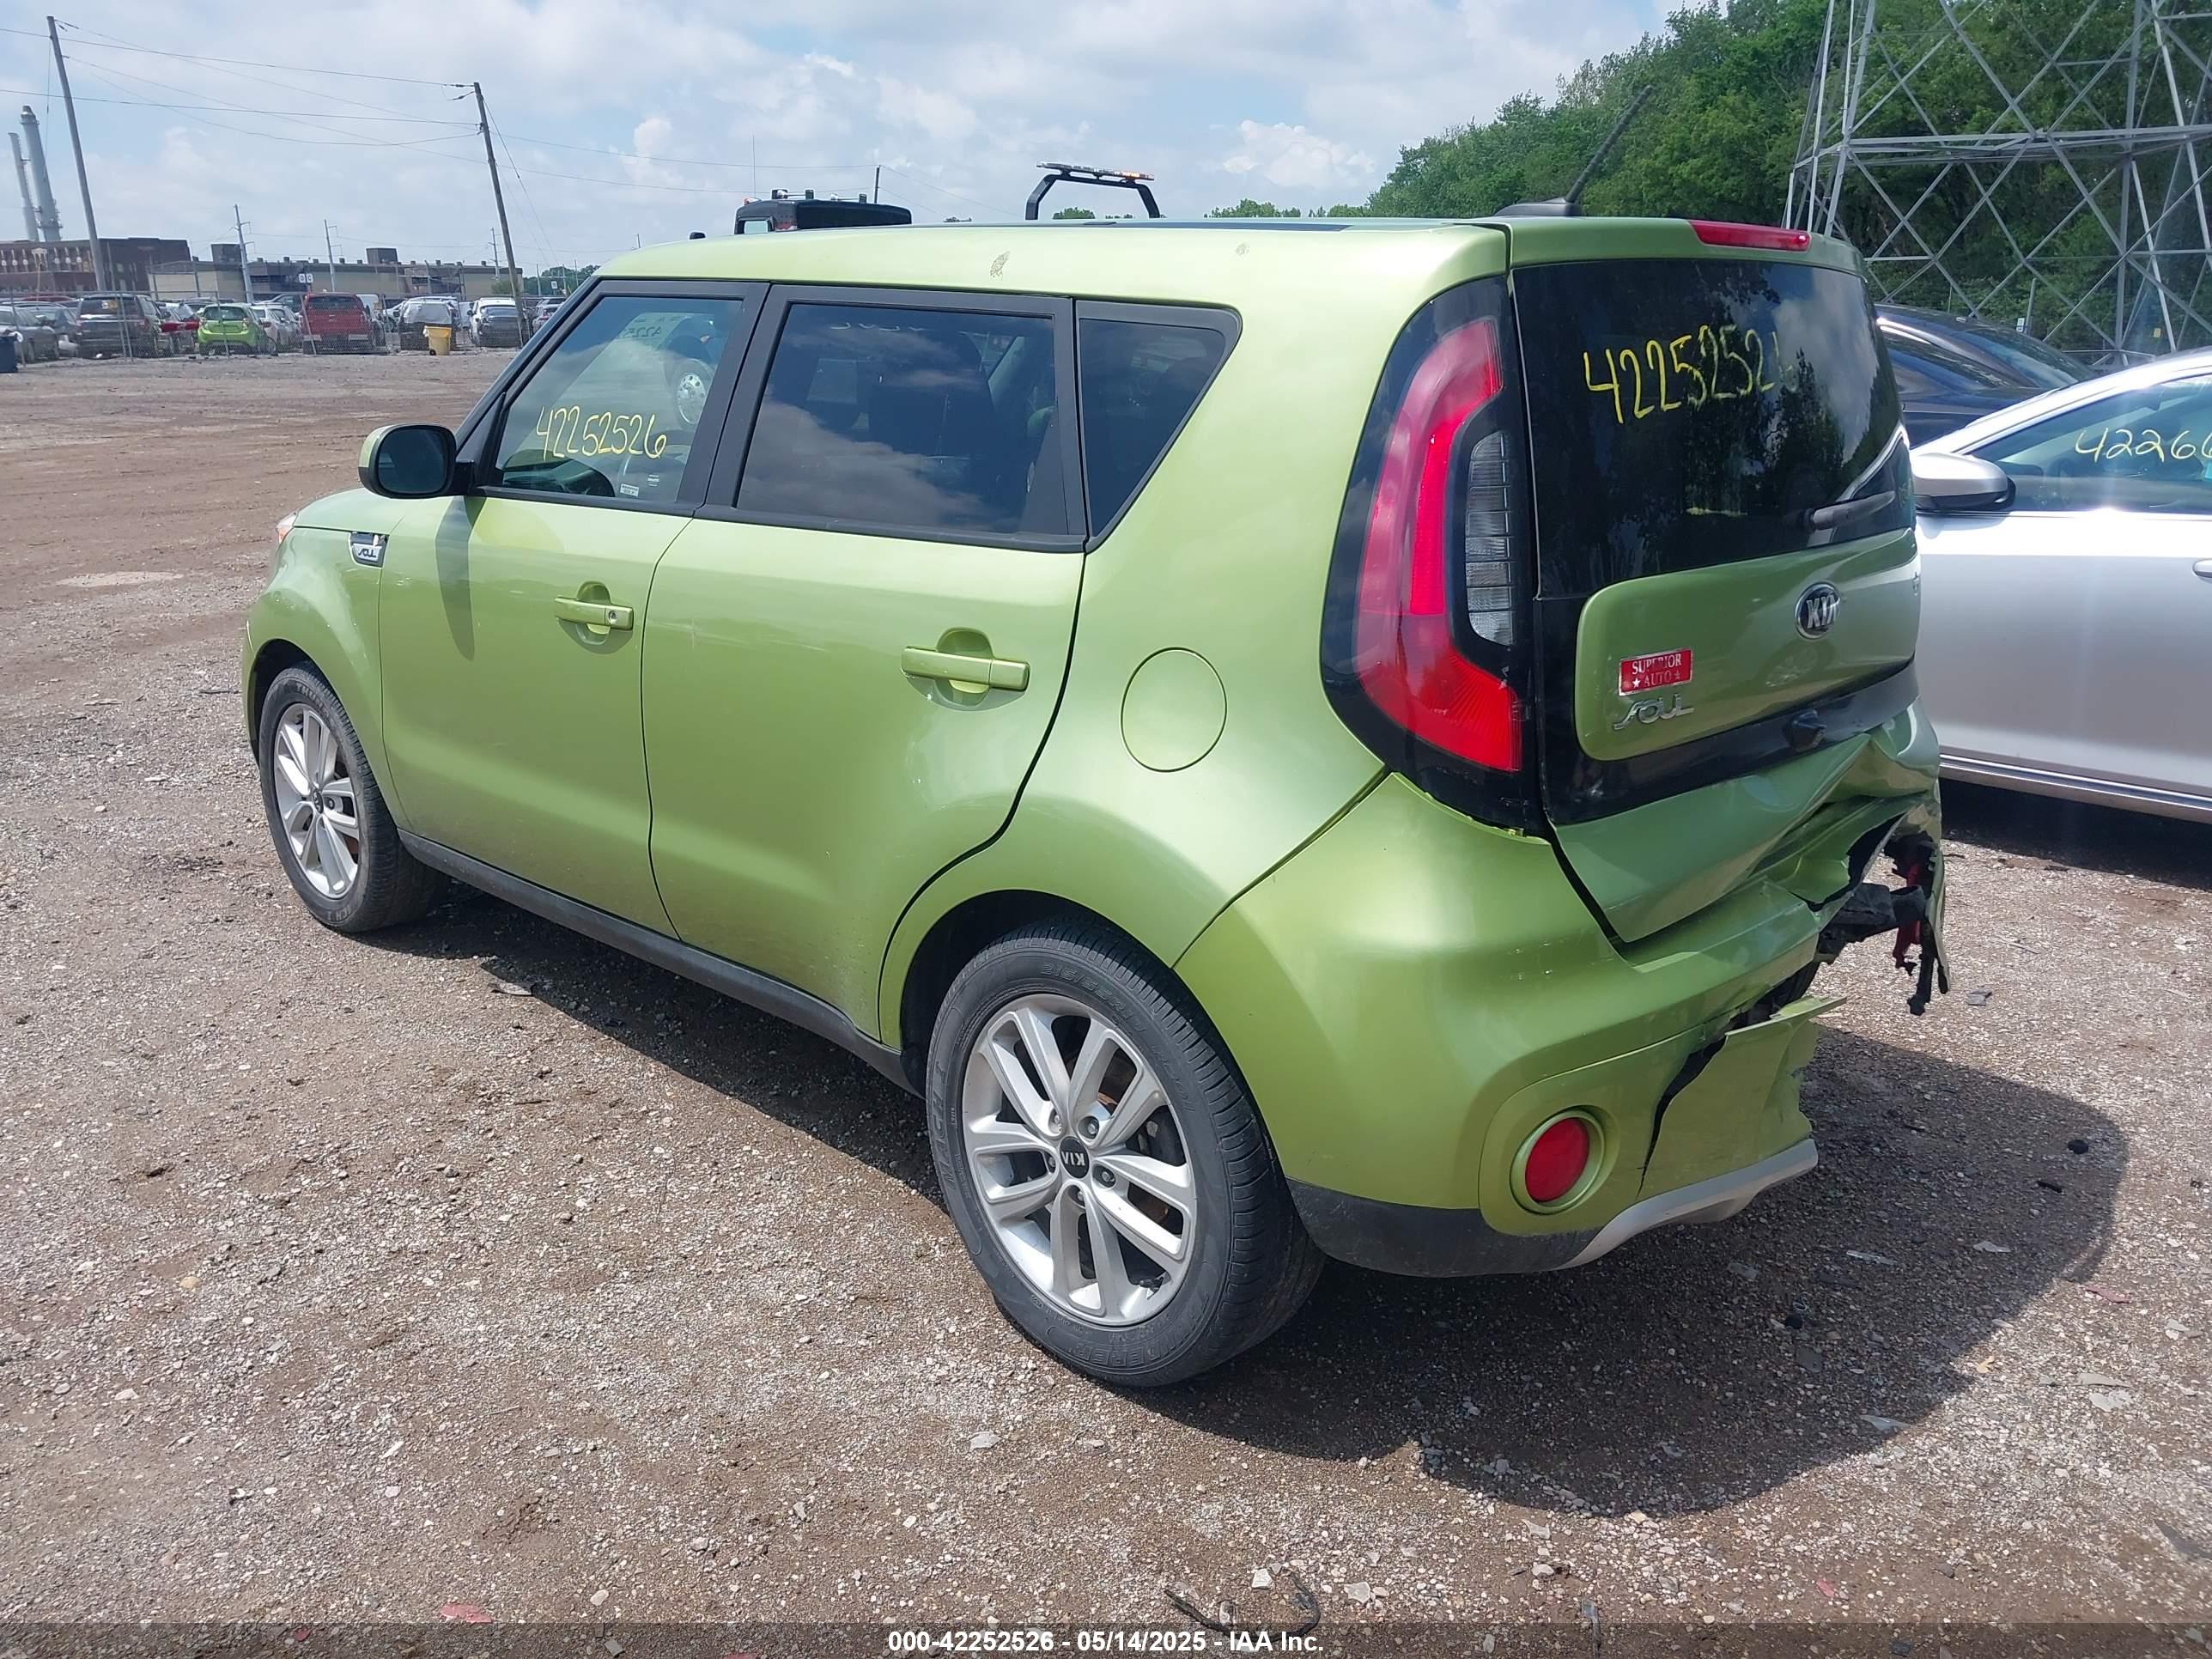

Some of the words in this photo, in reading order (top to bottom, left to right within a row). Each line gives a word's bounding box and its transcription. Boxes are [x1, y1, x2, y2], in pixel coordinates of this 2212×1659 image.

[536, 405, 666, 460] 42252526
[1806, 593, 1838, 629] KIA
[1644, 670, 1672, 687] AUTO
[1060, 1151, 1086, 1167] KIA
